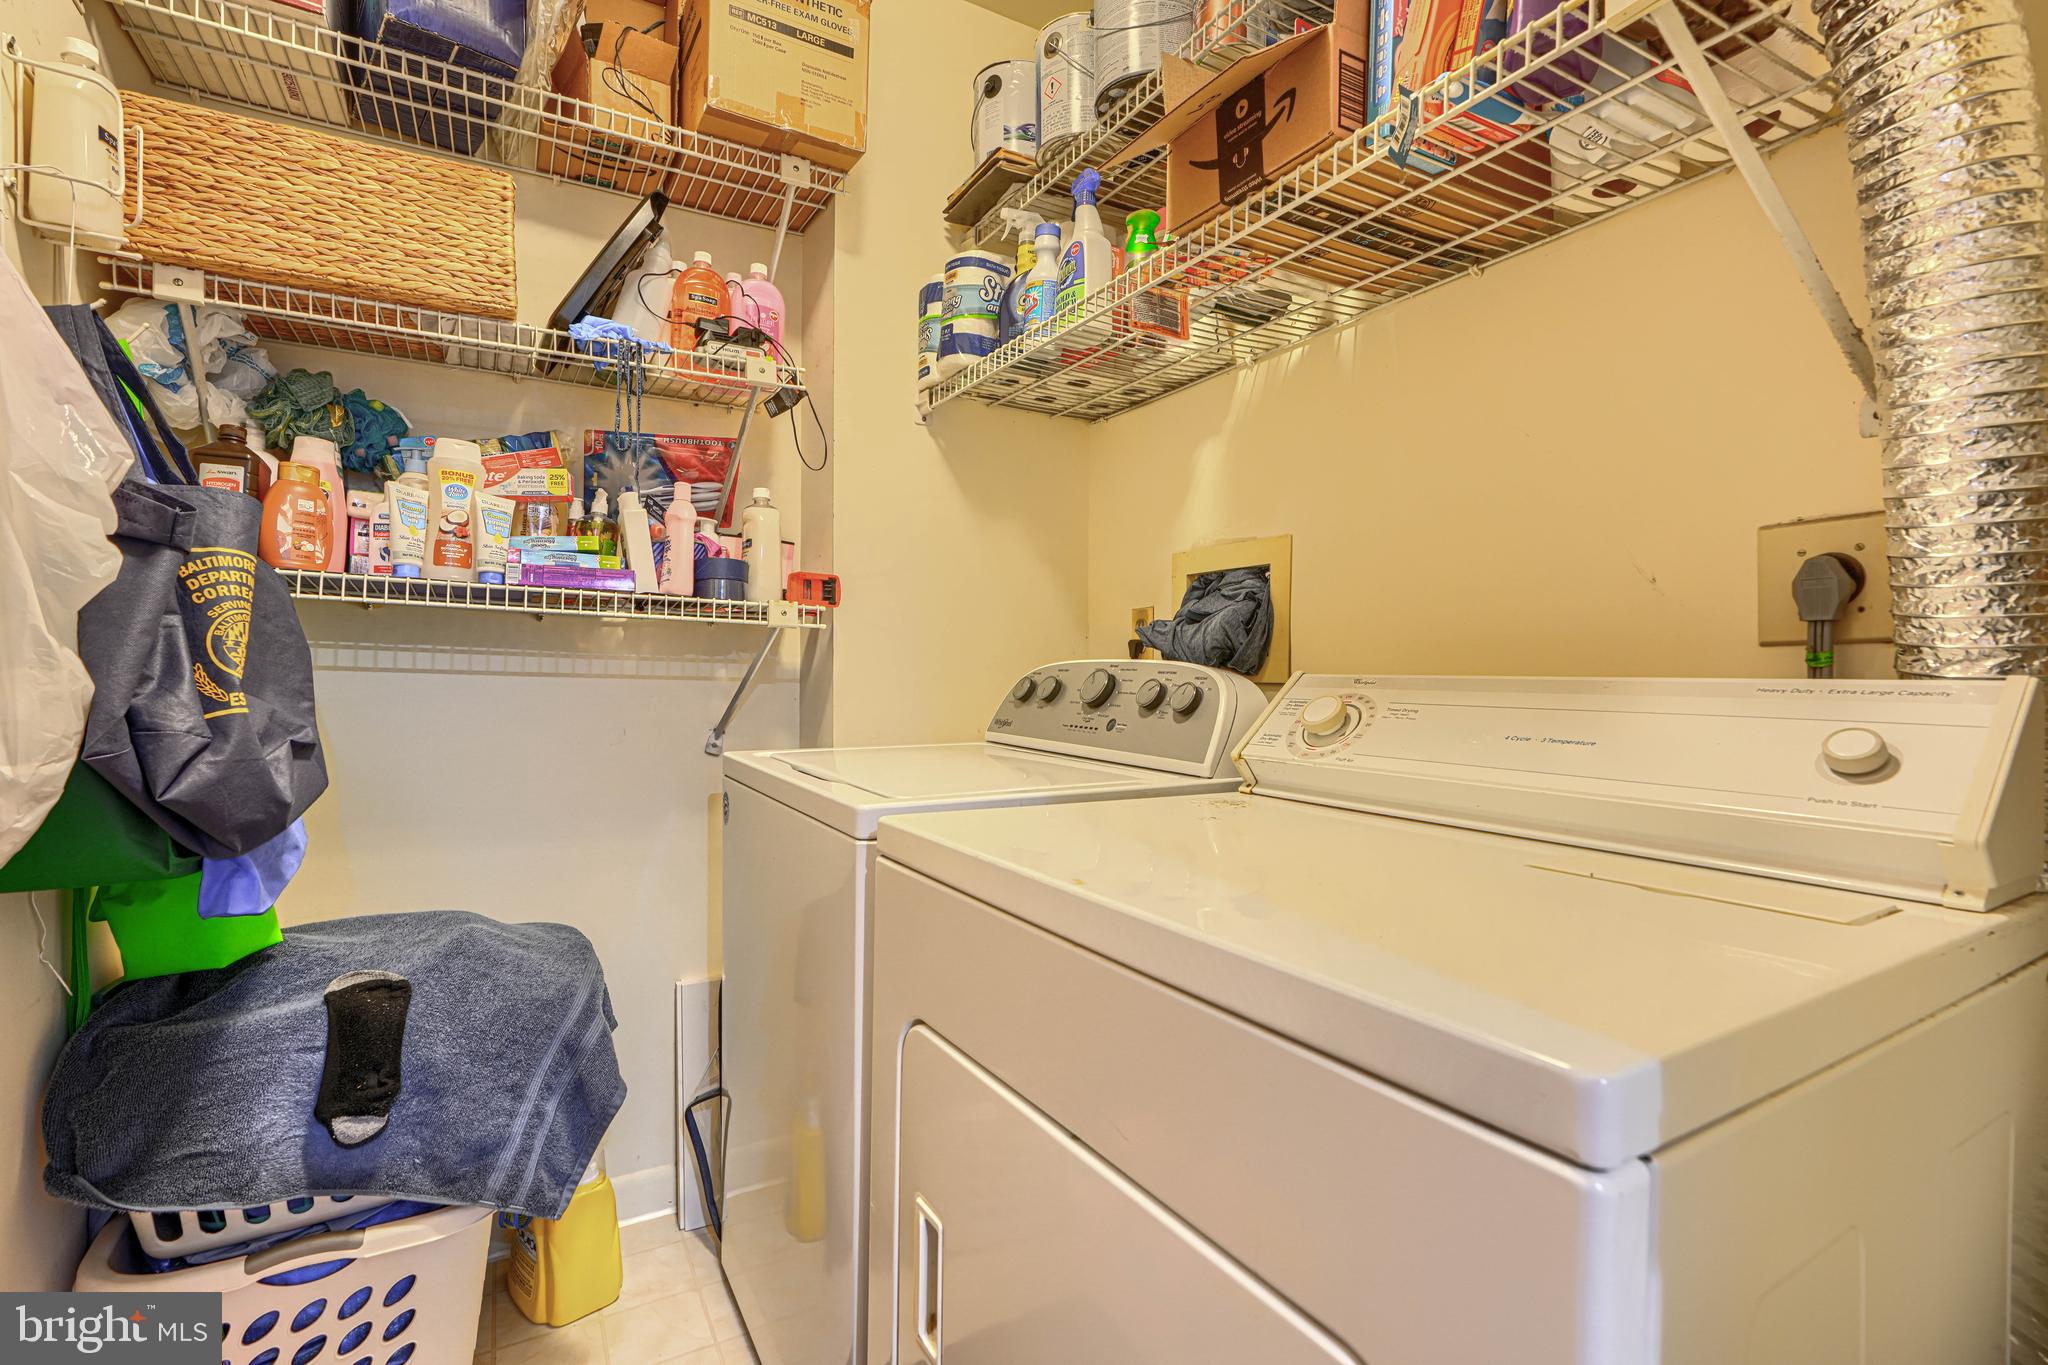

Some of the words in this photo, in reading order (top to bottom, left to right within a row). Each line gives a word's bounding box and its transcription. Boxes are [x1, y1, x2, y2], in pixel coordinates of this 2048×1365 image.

[793, 7, 819, 23] EXAM
[820, 18, 854, 36] GLOVES
[747, 13, 777, 30] MC513
[796, 29, 826, 47] LARGE
[664, 437, 723, 447] TOOTHBRUSH
[441, 470, 475, 480] BONUS
[549, 473, 566, 481] 25%
[178, 555, 256, 577] BALTIMORE
[1547, 738, 1597, 746] Temperature
[1807, 796, 1834, 804] Push
[1850, 800, 1877, 808] Start
